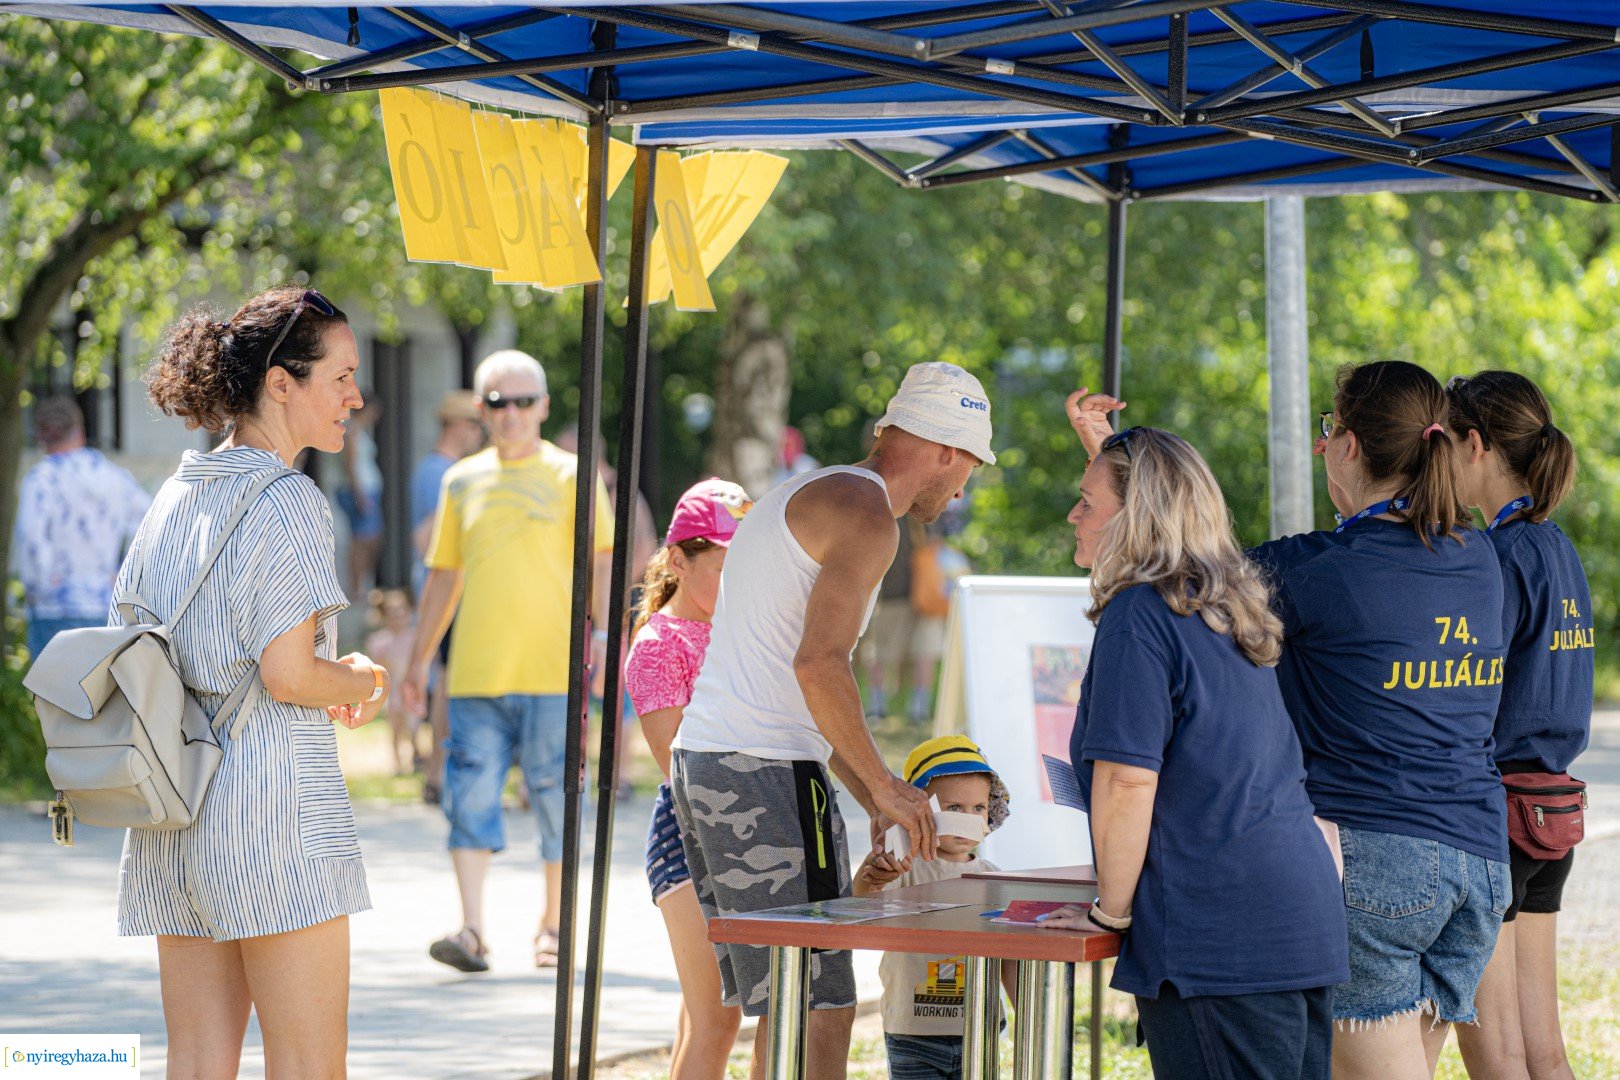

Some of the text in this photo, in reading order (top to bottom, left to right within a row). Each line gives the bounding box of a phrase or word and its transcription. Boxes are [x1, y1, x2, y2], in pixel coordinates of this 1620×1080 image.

[1562, 598, 1580, 618] 74.
[1435, 616, 1478, 645] 74.
[1550, 624, 1594, 650] JULIÁLI
[914, 1005, 959, 1018] WORKING
